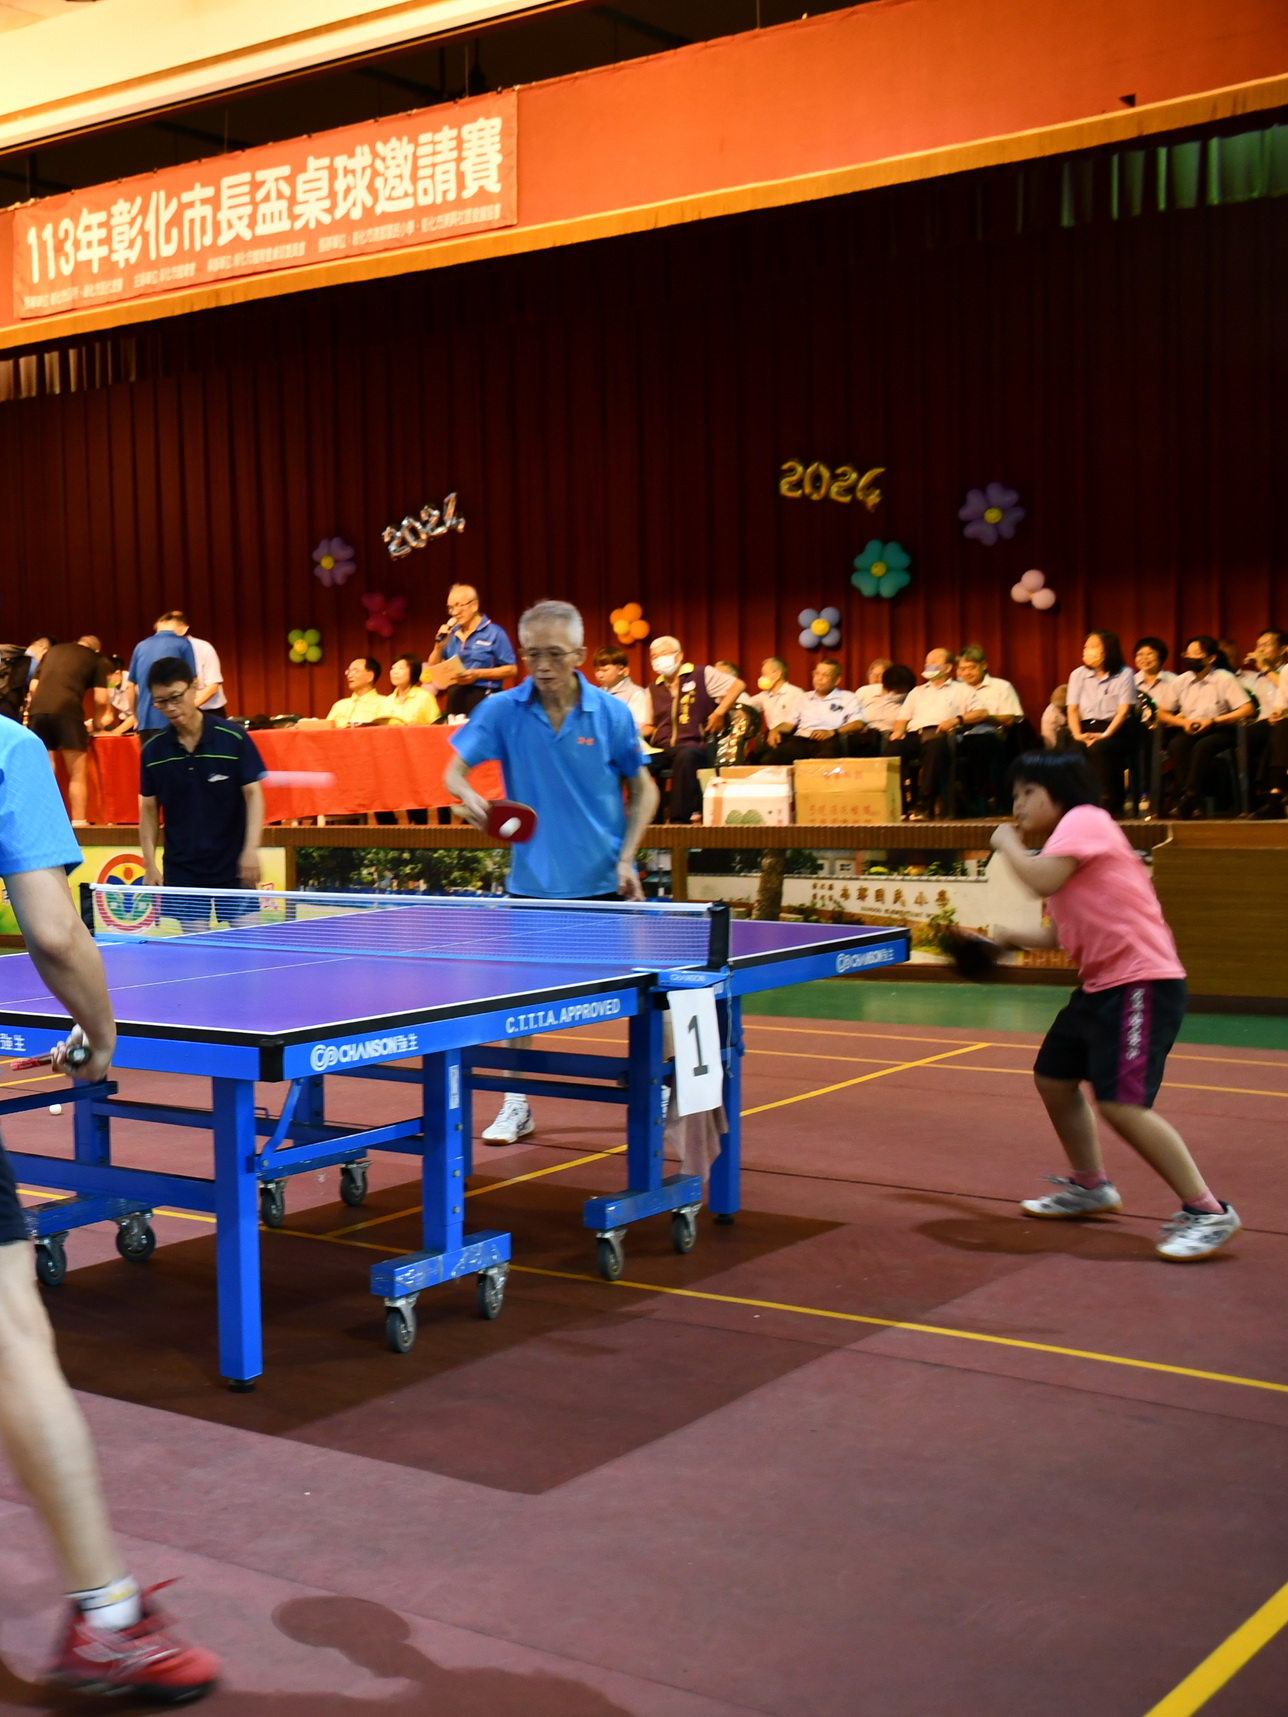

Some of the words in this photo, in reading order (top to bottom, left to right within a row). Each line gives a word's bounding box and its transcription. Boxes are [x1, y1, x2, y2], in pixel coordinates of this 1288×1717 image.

[26, 117, 503, 284] 113年彰化市長盃桌球邀請賽
[779, 460, 886, 512] 2024
[381, 492, 466, 561] 2024
[560, 998, 621, 1024] APPROVED
[339, 1036, 397, 1063] CHANSON
[688, 1015, 709, 1077] 1
